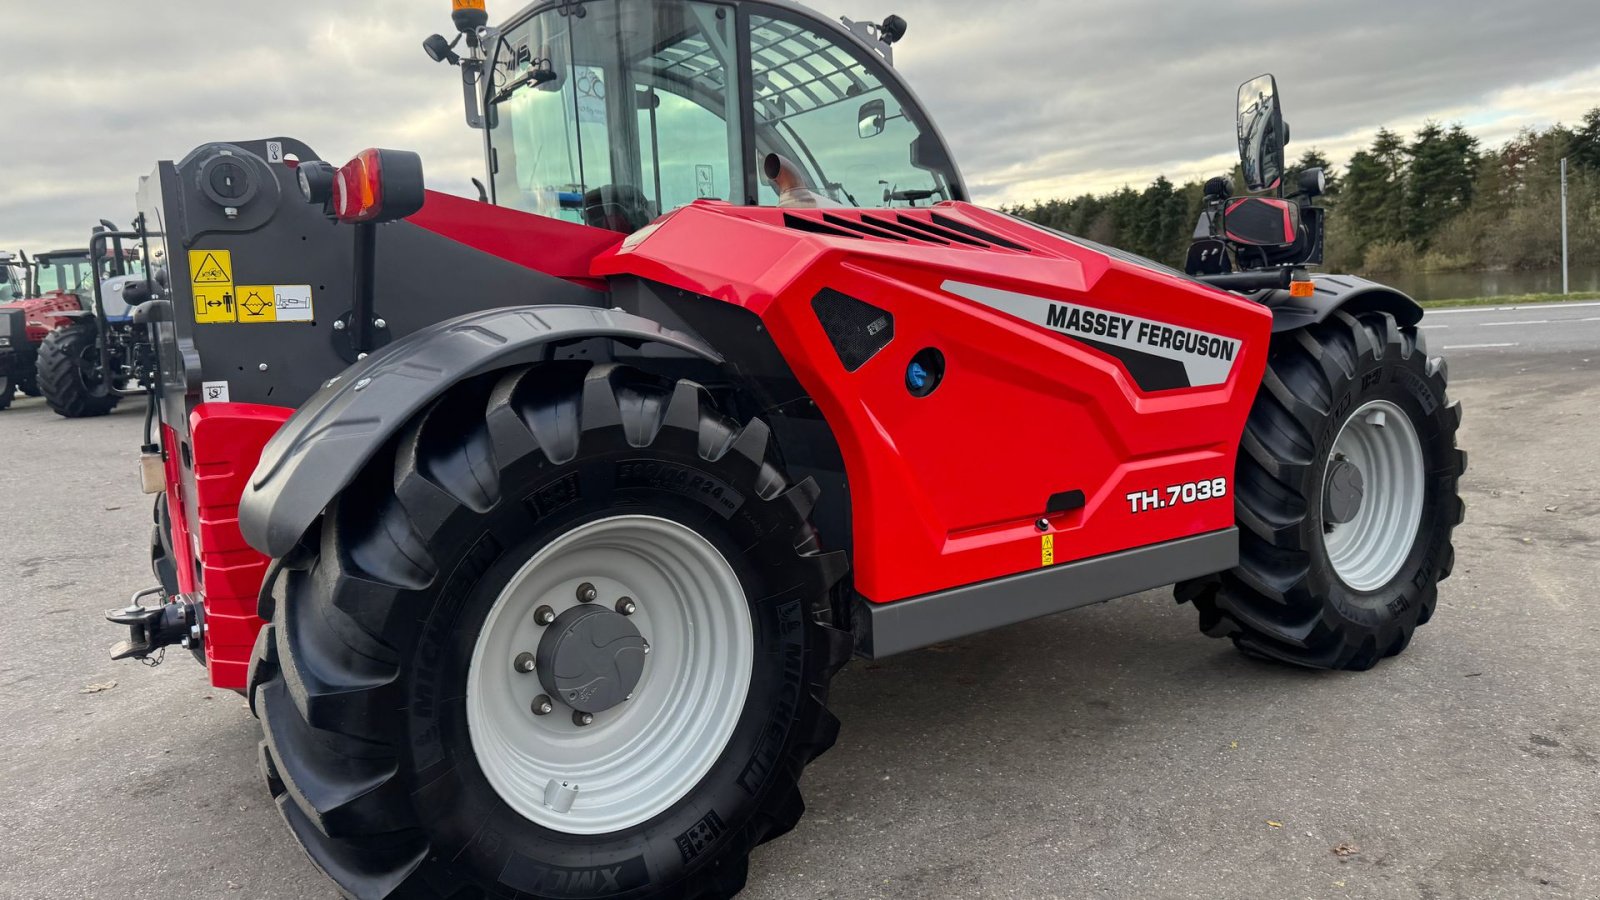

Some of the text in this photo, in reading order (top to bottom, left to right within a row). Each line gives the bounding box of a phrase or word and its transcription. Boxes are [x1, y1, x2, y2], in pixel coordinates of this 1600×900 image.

[1046, 303, 1235, 361] MASSEY FERGUSON
[1126, 477, 1227, 513] TH.7038
[742, 642, 802, 796] MICHELIN
